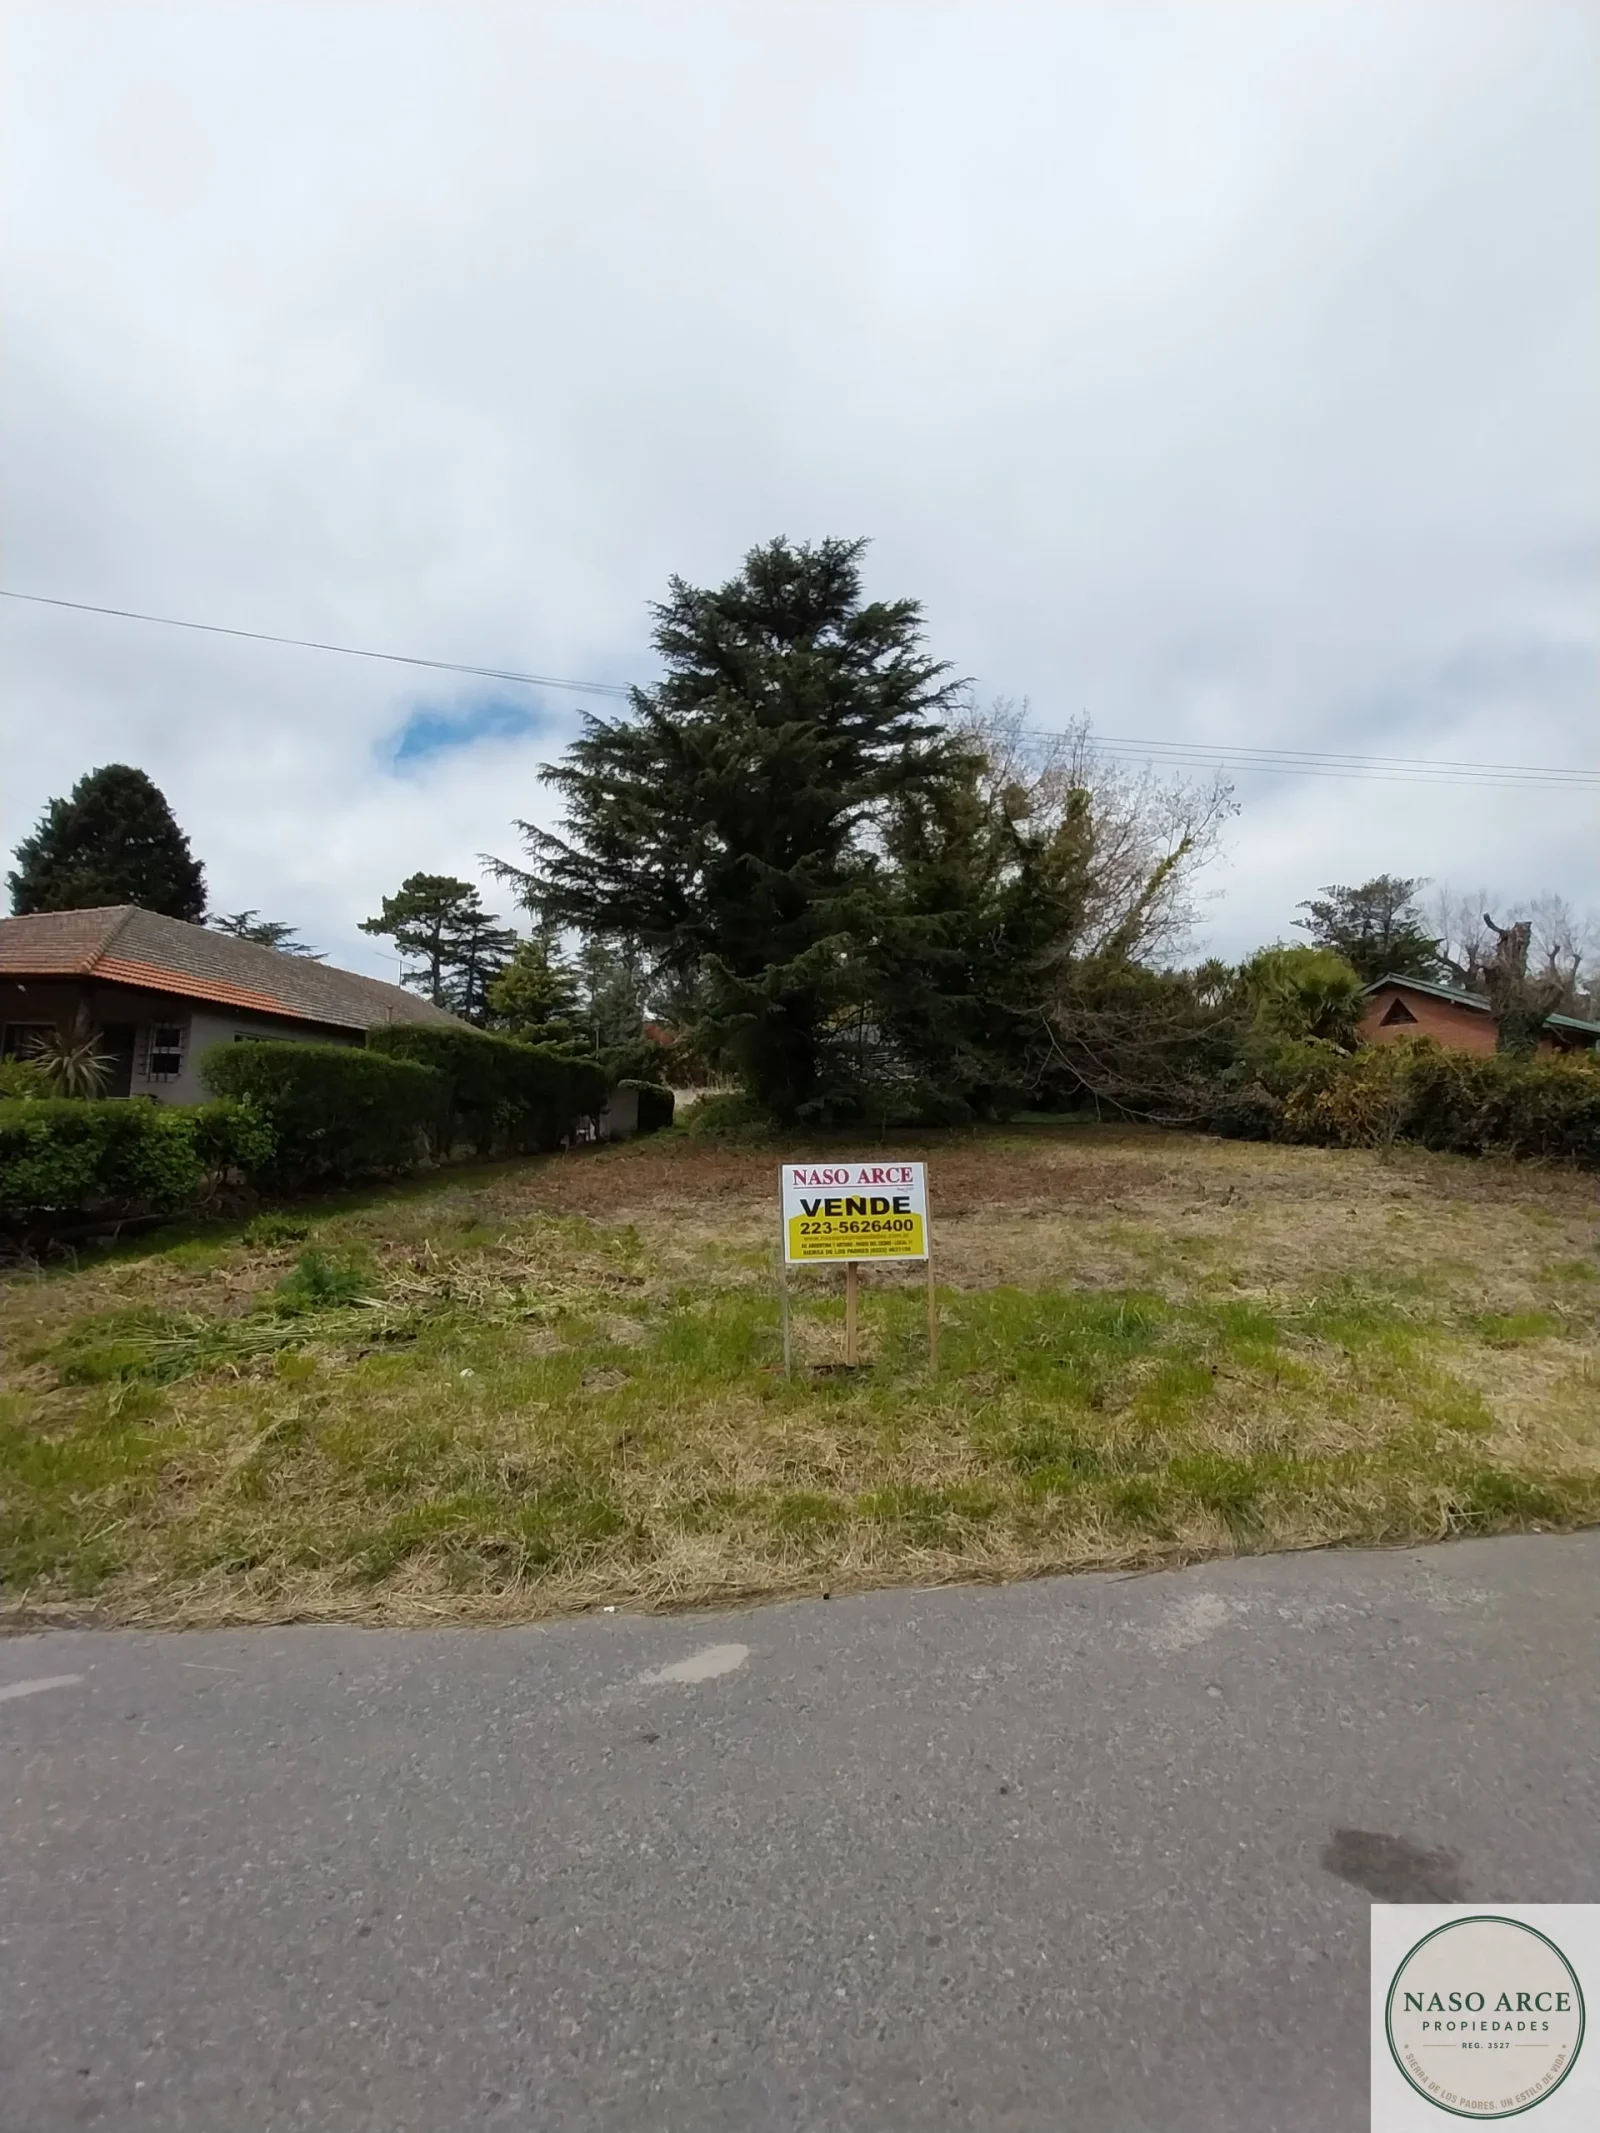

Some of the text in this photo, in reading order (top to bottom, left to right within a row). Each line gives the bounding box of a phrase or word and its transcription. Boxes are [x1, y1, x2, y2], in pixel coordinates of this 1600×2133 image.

[792, 1166, 914, 1186] NASO ARCE
[799, 1196, 912, 1217] VENDE
[800, 1219, 914, 1235] 223-5626400
